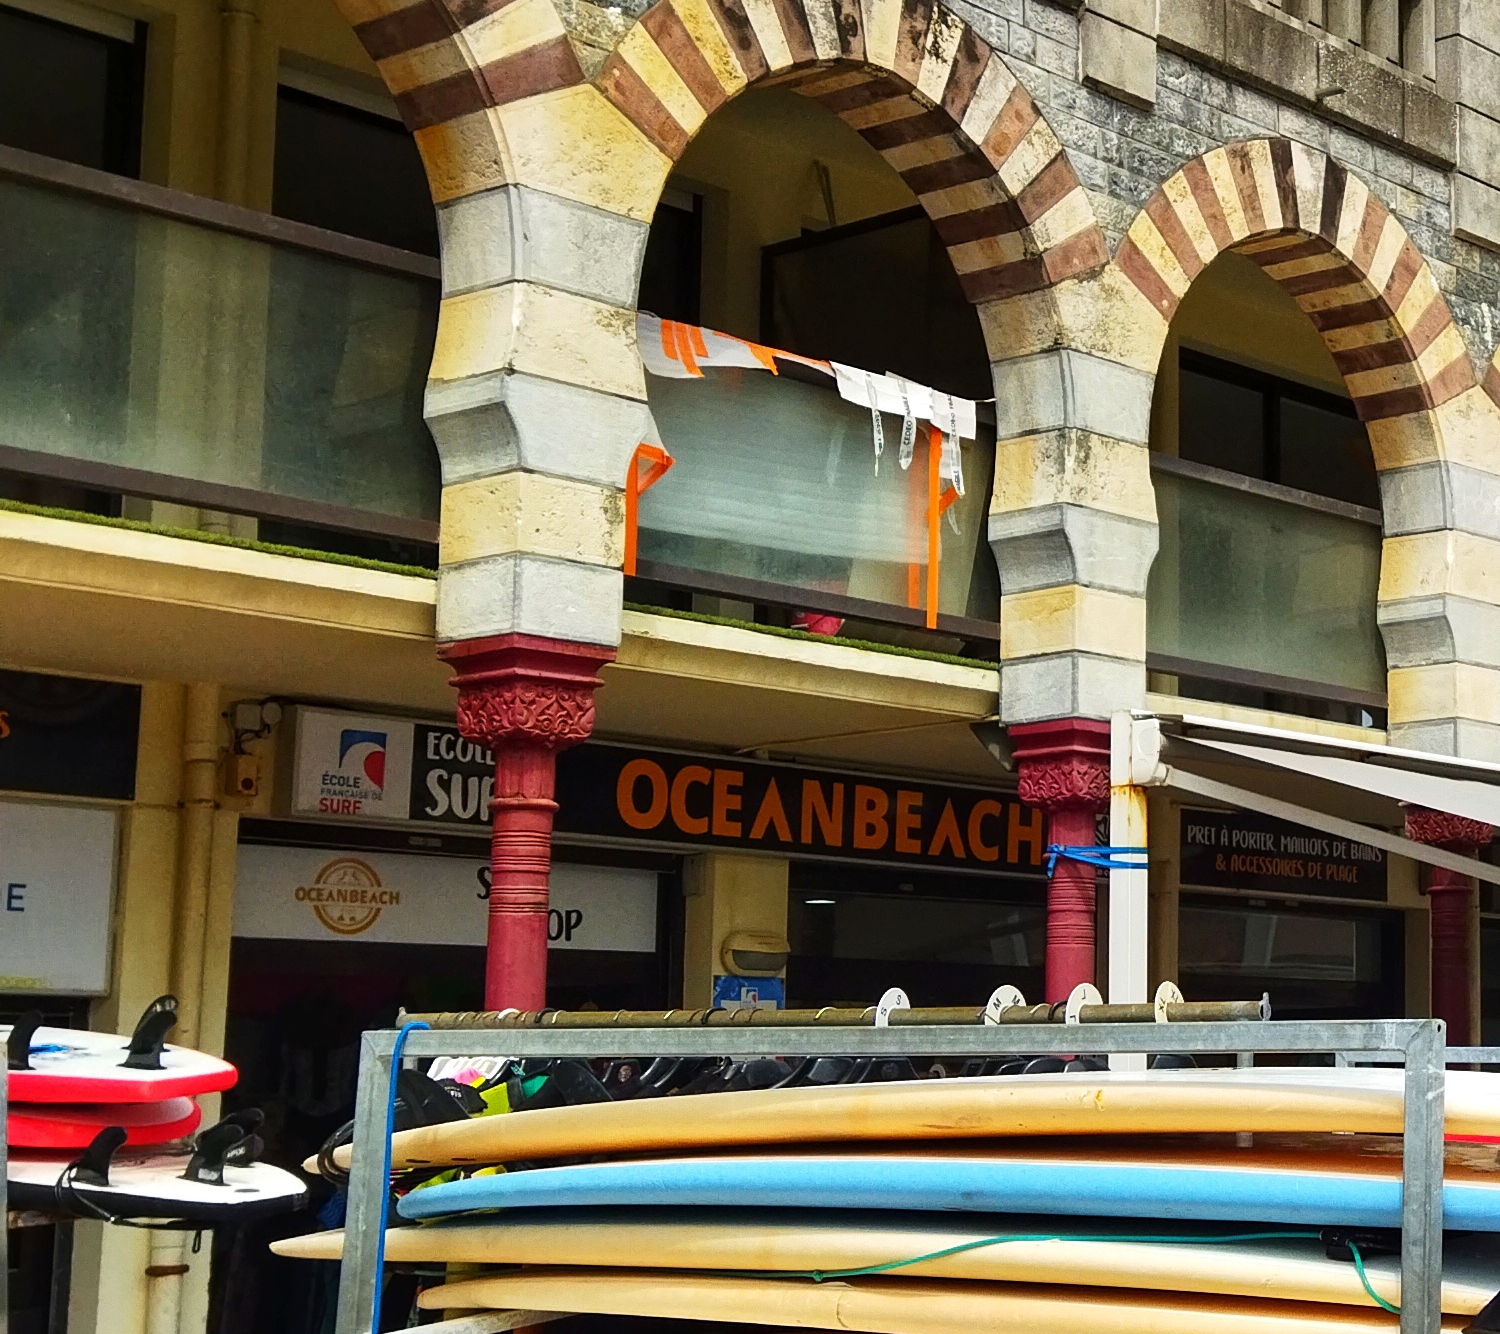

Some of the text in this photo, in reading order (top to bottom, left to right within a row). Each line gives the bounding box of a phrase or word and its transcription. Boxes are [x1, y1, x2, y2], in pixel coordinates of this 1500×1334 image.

[321, 771, 361, 789] ÉCOLE
[319, 797, 362, 815] SURF
[616, 759, 1042, 866] OCEANBEACH
[1187, 824, 1216, 845] PRET
[1220, 825, 1228, 847] À
[1280, 835, 1329, 858] MAILLOTS
[1333, 840, 1347, 860] DE
[1351, 842, 1382, 863] BAINS
[1216, 853, 1358, 883] & ACCESSOIRES DE PLAGE
[295, 886, 400, 906] OCEANBEACH
